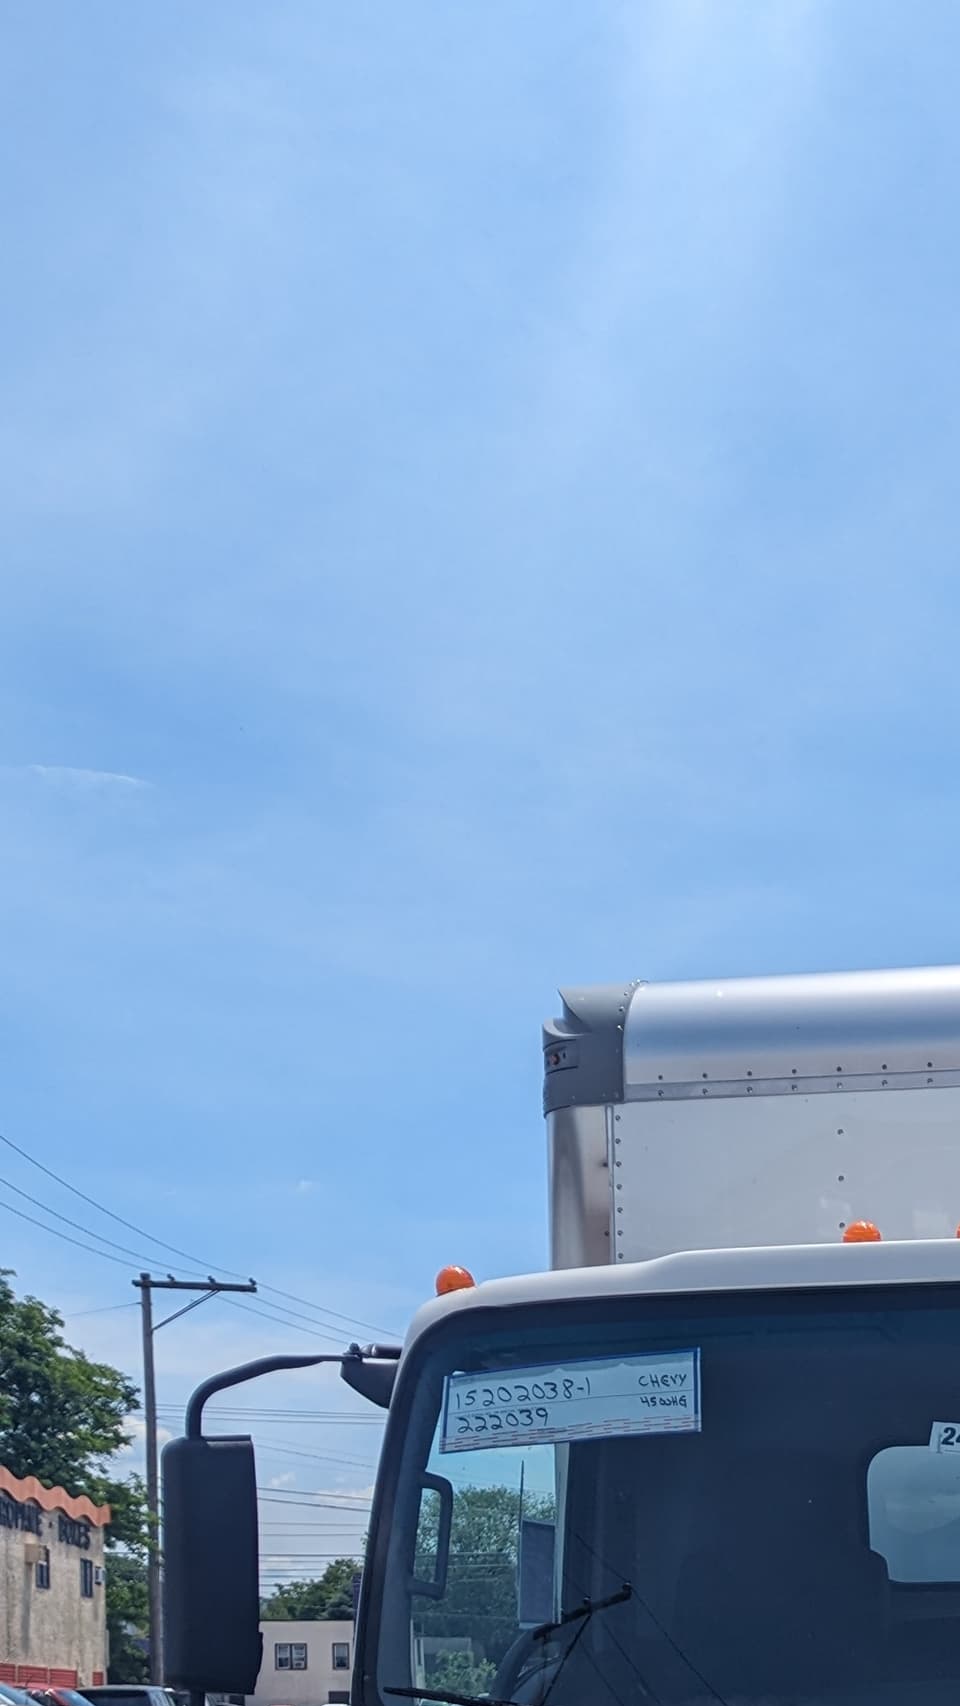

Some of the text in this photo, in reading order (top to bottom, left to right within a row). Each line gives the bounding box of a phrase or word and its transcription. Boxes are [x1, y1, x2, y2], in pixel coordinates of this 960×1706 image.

[456, 1376, 591, 1409] 15202038-1
[638, 1374, 687, 1388] CHEVY
[457, 1407, 549, 1434] 222039
